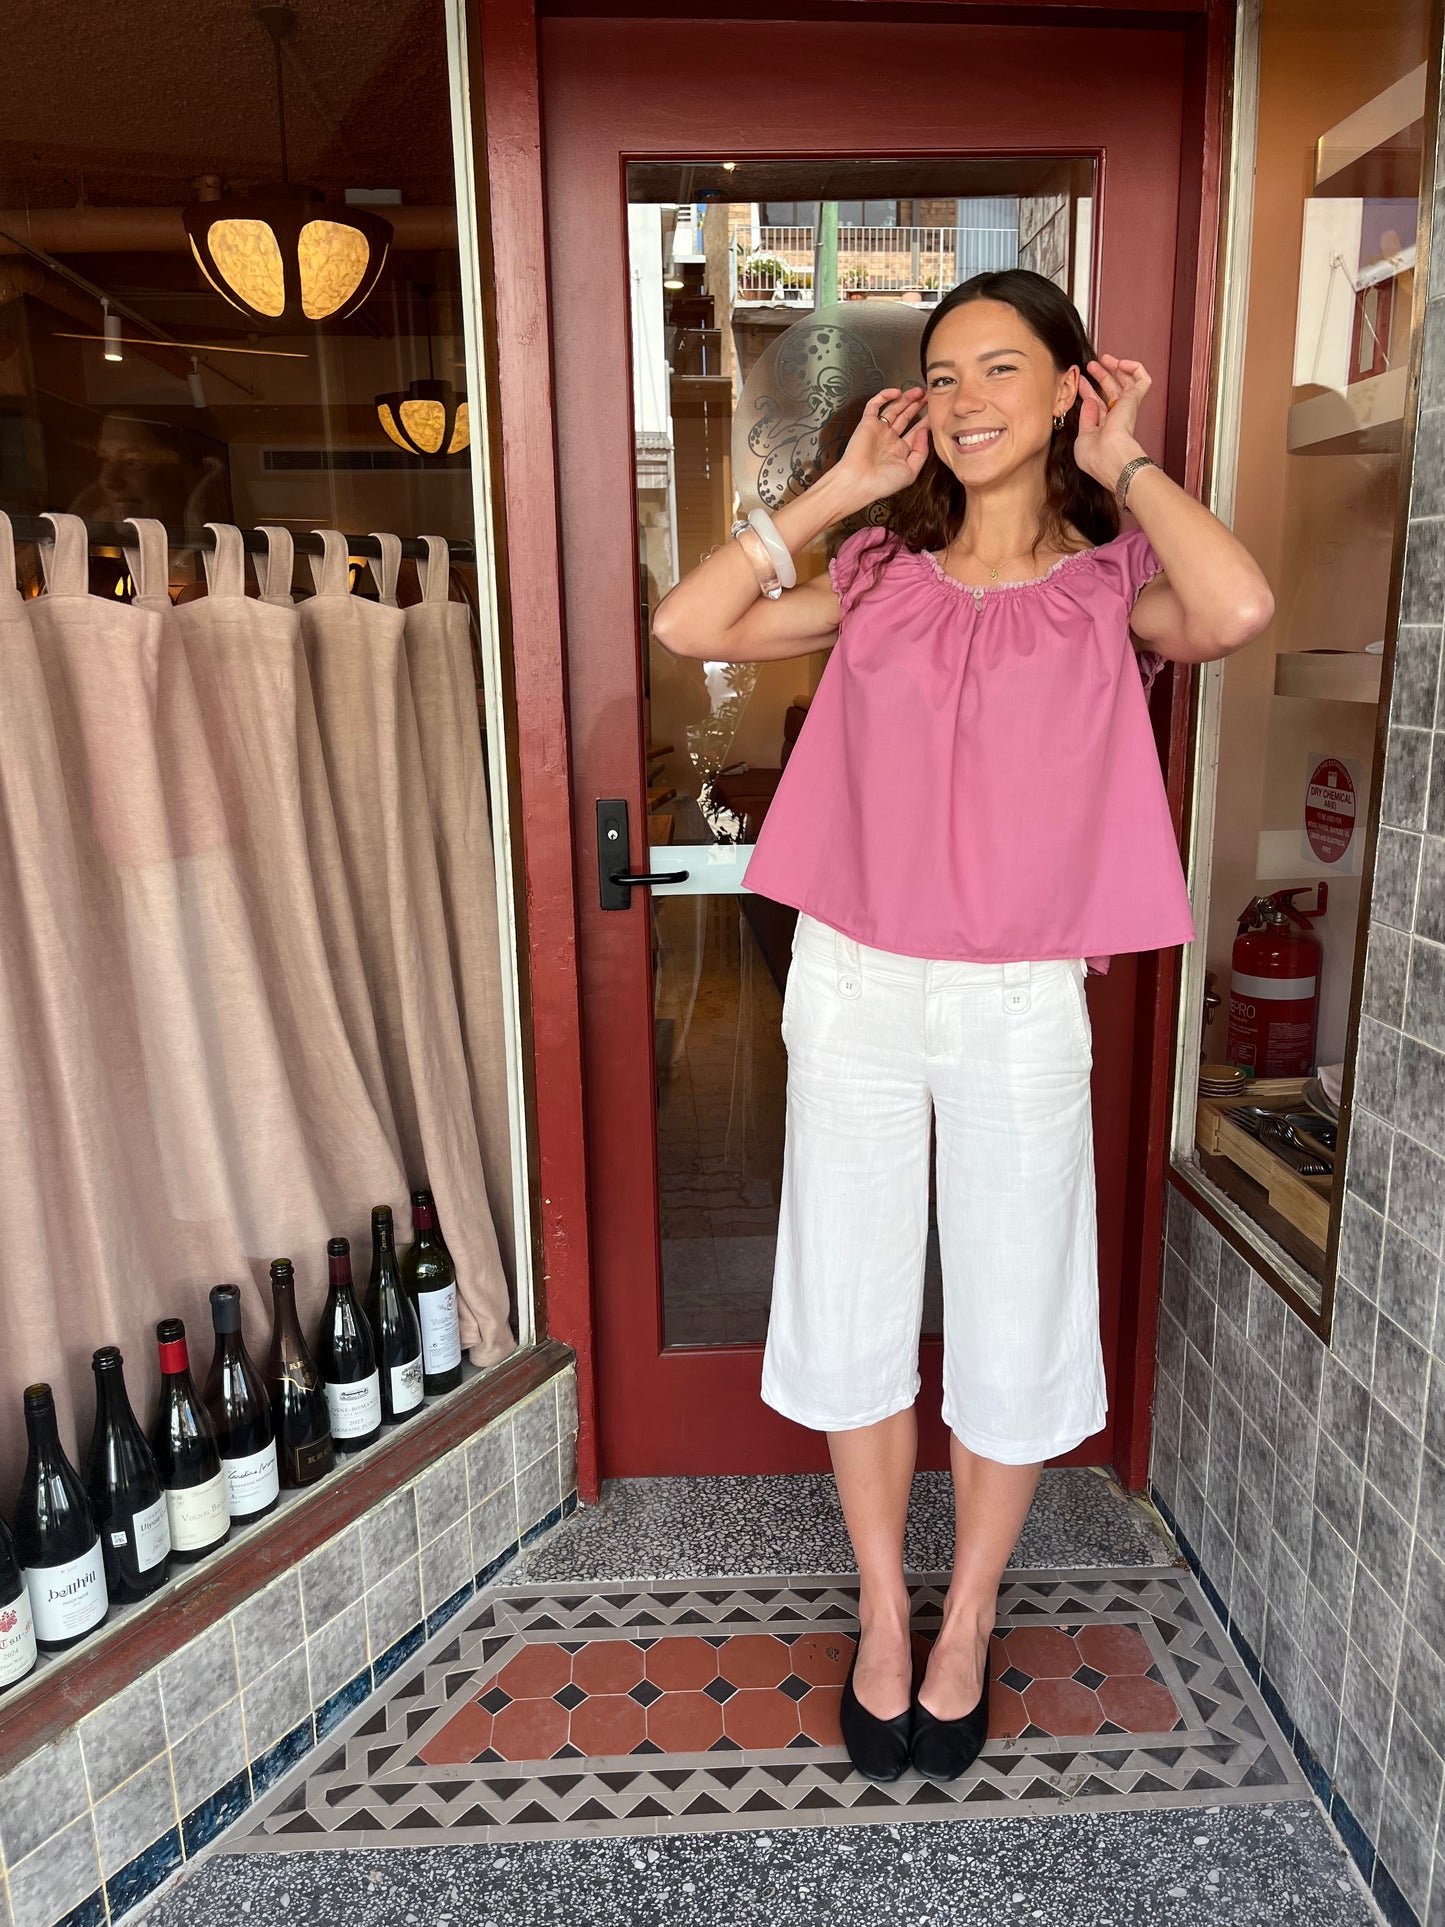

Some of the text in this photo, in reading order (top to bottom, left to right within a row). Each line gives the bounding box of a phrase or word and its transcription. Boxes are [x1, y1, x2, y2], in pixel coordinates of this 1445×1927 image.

[1311, 786, 1352, 804] DRY CHEMICAL
[47, 1570, 97, 1603] bellhill
[3, 1648, 19, 1659] 2024
